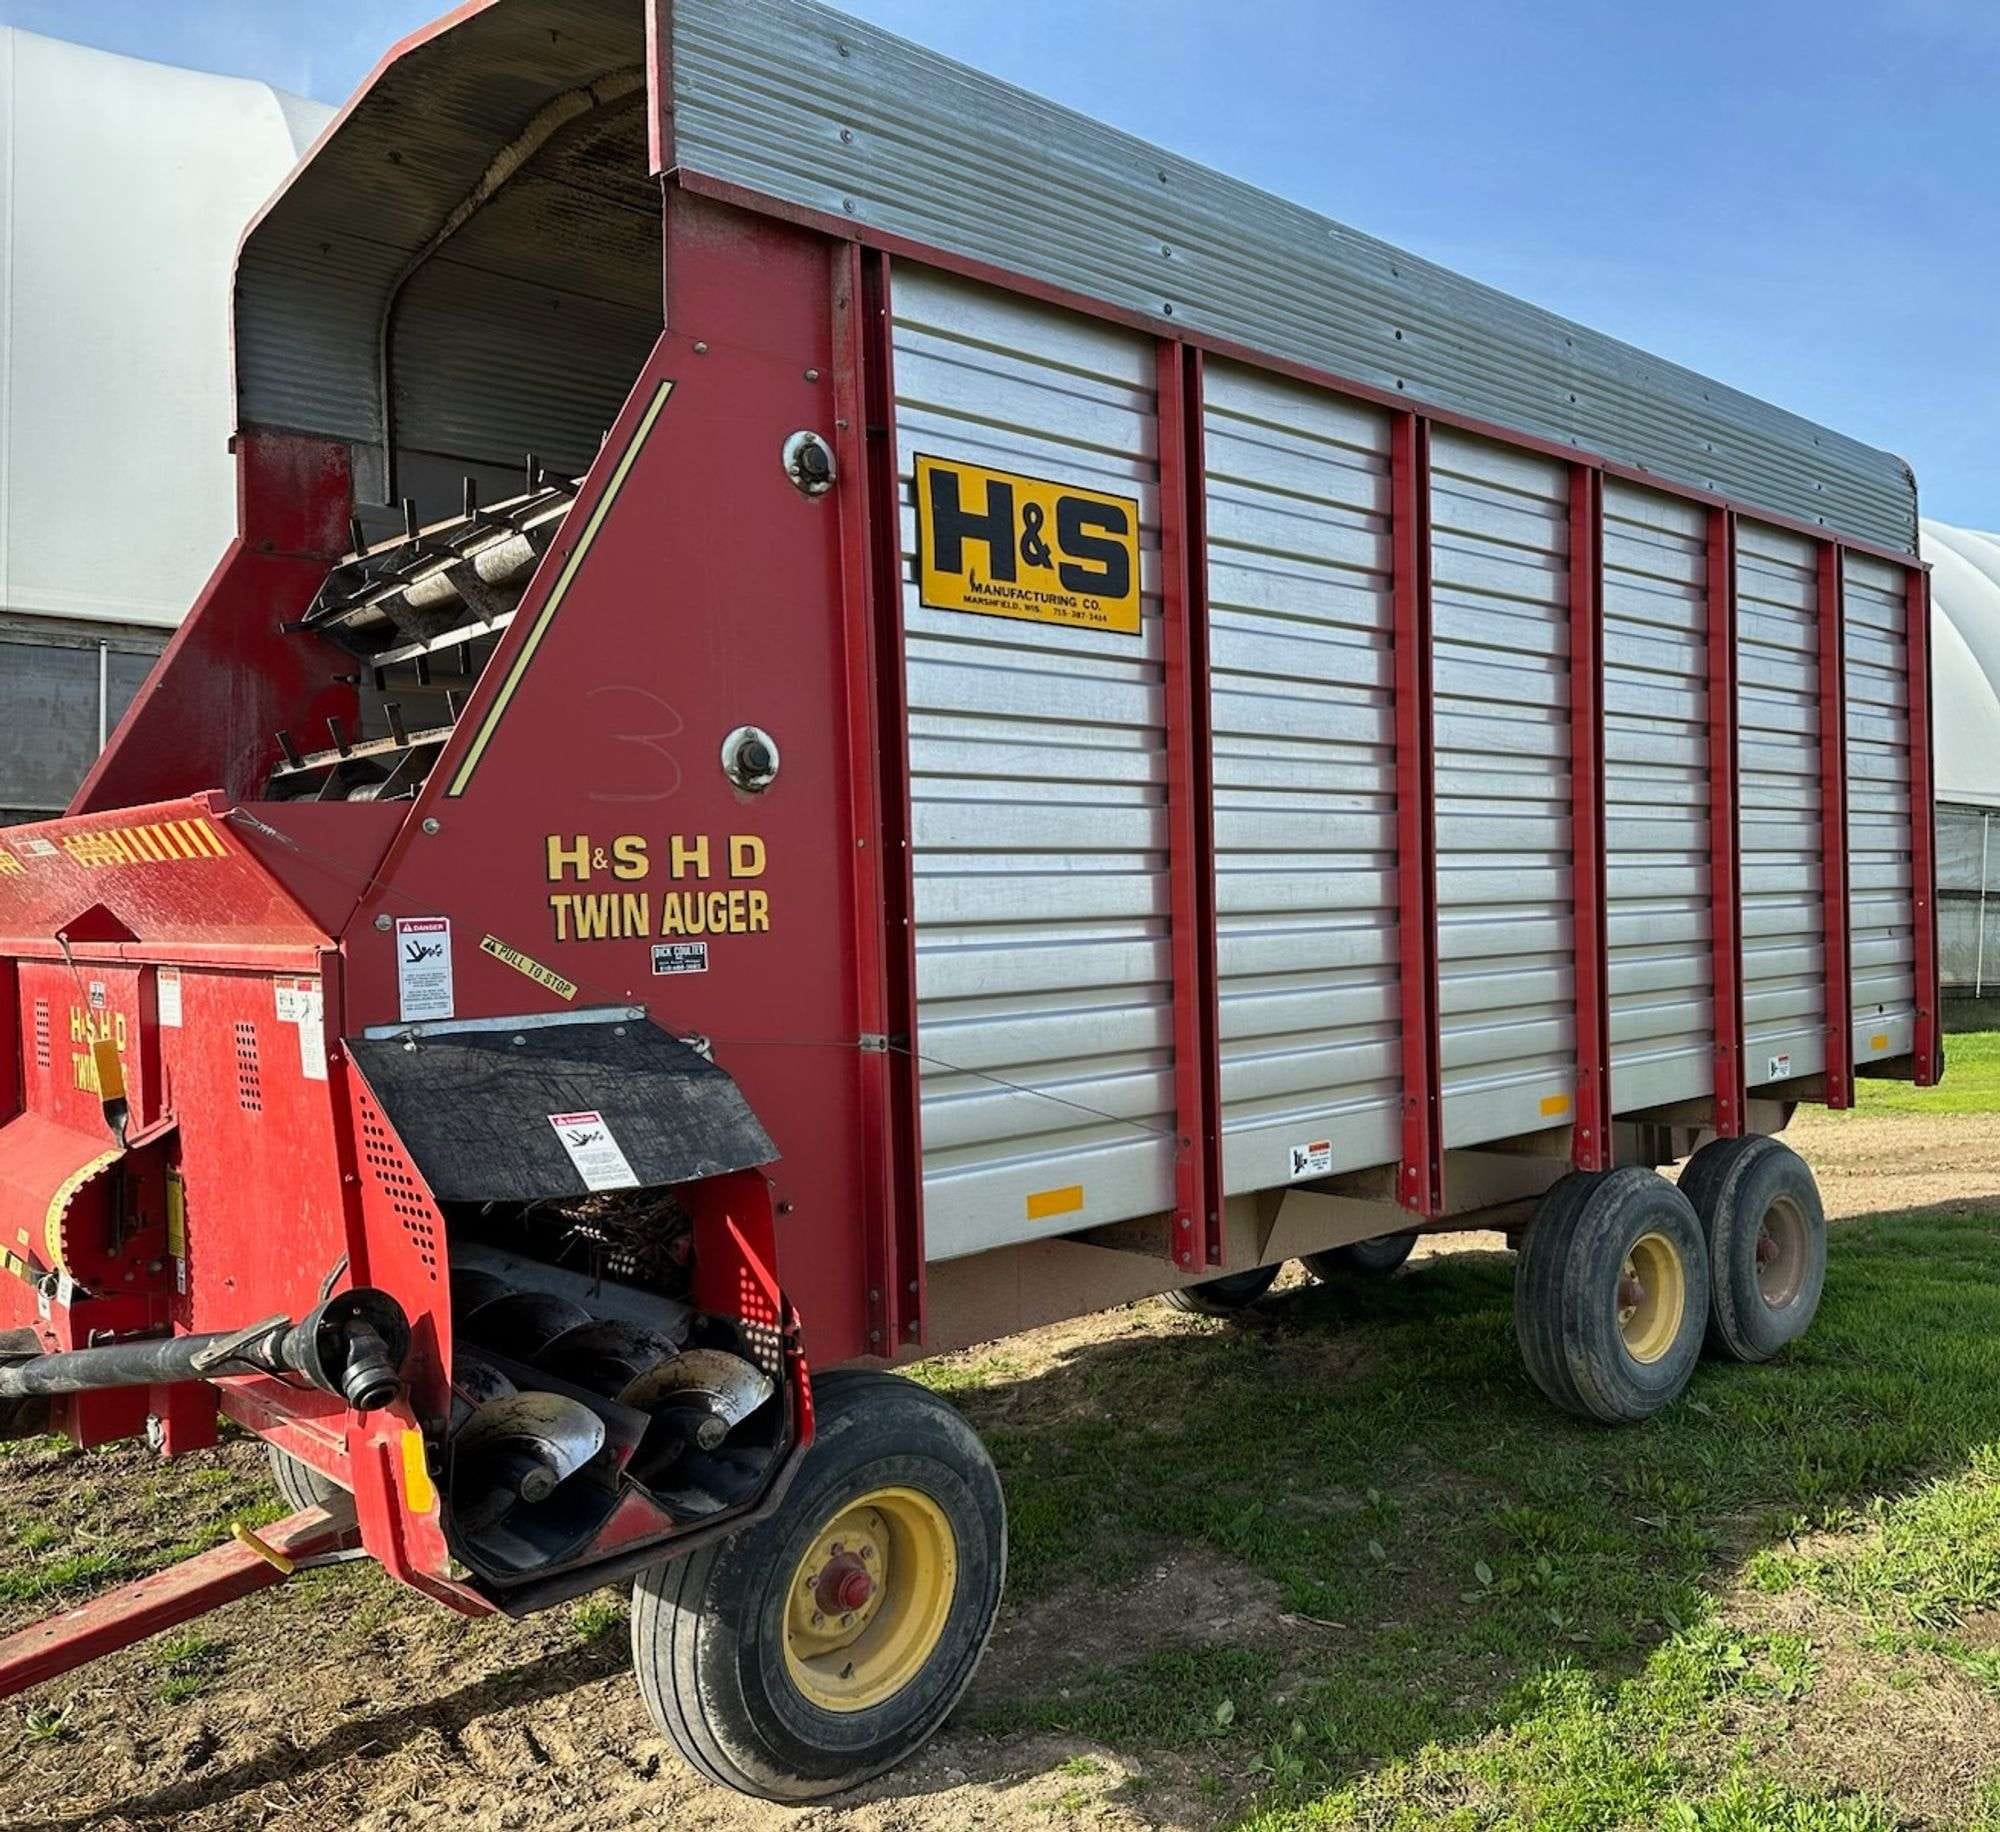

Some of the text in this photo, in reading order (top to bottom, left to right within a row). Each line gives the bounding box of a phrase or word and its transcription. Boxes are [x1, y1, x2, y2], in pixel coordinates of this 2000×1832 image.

[929, 468, 1129, 599] H&S
[971, 583, 1102, 611] MANUFACTURING CO.
[546, 834, 650, 881] H&S
[413, 924, 444, 932] DANGER
[549, 889, 769, 940] TWIN AUGER
[498, 945, 571, 993] PULL TO STOP
